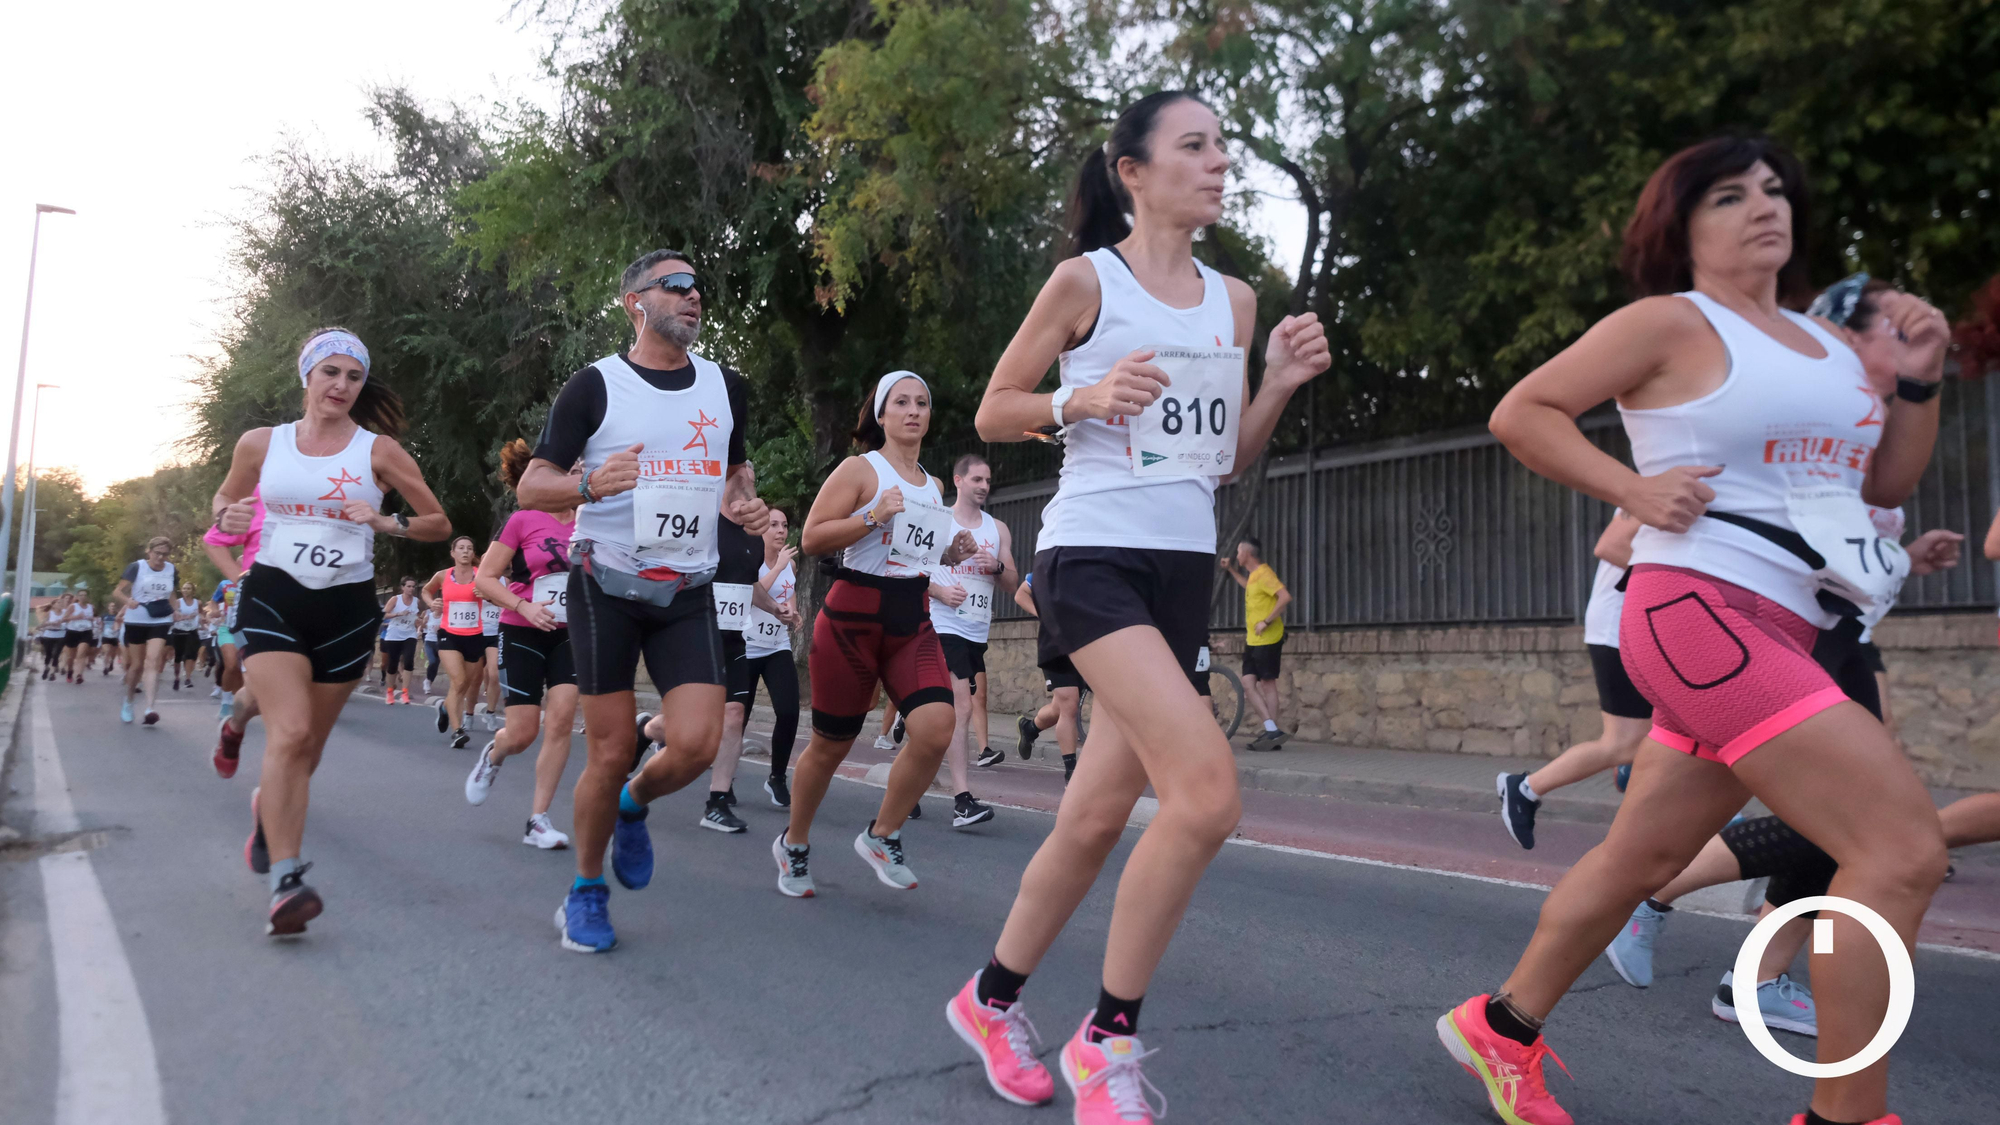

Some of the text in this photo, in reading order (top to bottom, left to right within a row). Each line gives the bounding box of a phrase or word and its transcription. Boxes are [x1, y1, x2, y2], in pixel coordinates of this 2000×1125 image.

[1162, 396, 1226, 436] 810
[656, 513, 700, 538] 794
[906, 523, 934, 550] 764
[293, 542, 344, 568] 762
[719, 602, 744, 616] 761
[970, 593, 988, 609] 139
[453, 612, 476, 620] 1185
[758, 622, 781, 636] 137
